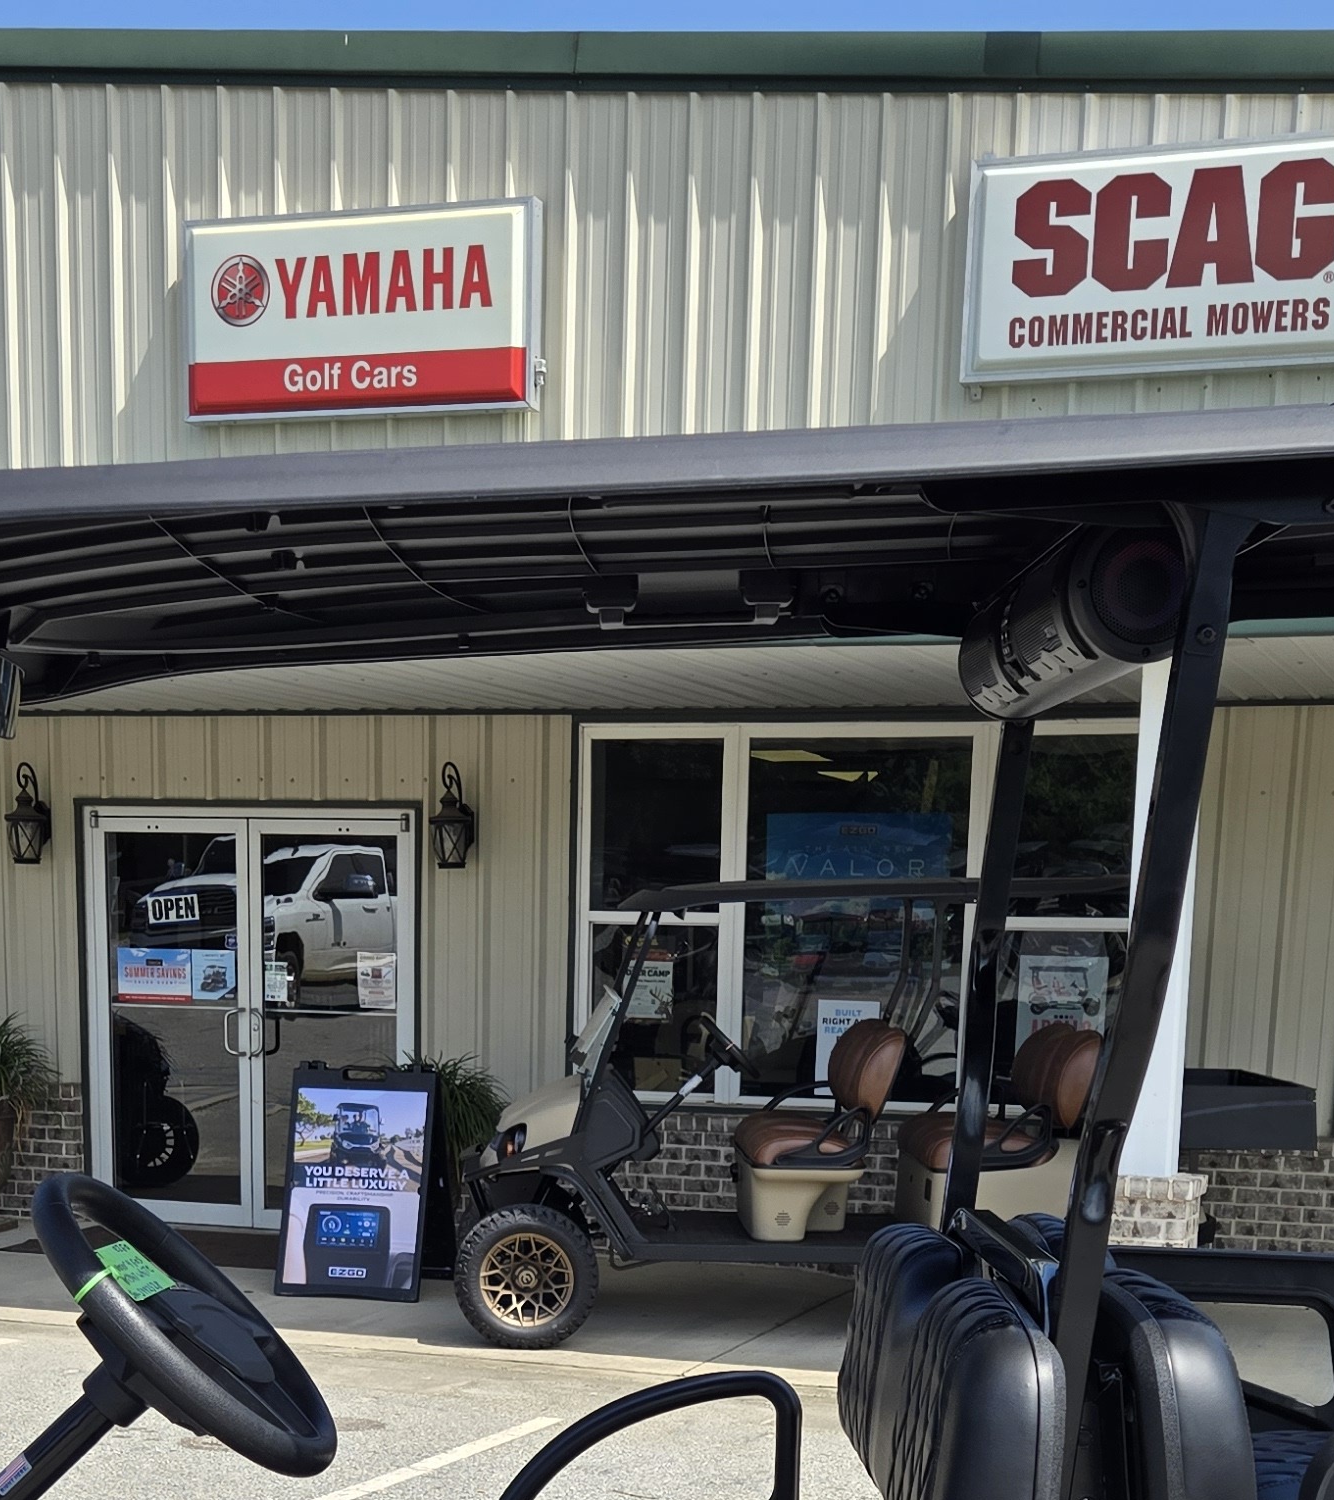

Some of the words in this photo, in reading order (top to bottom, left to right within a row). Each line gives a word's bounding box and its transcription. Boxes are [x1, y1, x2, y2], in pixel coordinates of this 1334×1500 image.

[274, 244, 493, 320] YAMAHA
[1008, 306, 1193, 348] COMMERCIAL
[1206, 297, 1331, 337] MOWERS
[283, 362, 342, 393] Golf
[350, 360, 418, 390] Cars
[789, 858, 926, 877] VALOR
[151, 896, 196, 921] OPEN
[124, 966, 156, 979] SUMMER
[156, 966, 187, 980] SAVINGS
[648, 969, 671, 977] CAMP
[835, 1008, 863, 1017] BUILT
[822, 1017, 852, 1025] RIGHT
[304, 1165, 333, 1177] YOU
[335, 1166, 396, 1179] DESERVE
[397, 1169, 410, 1180] A
[305, 1177, 349, 1188] LITTLE
[351, 1179, 408, 1191] LUXURY
[330, 1268, 365, 1277] EZGO
